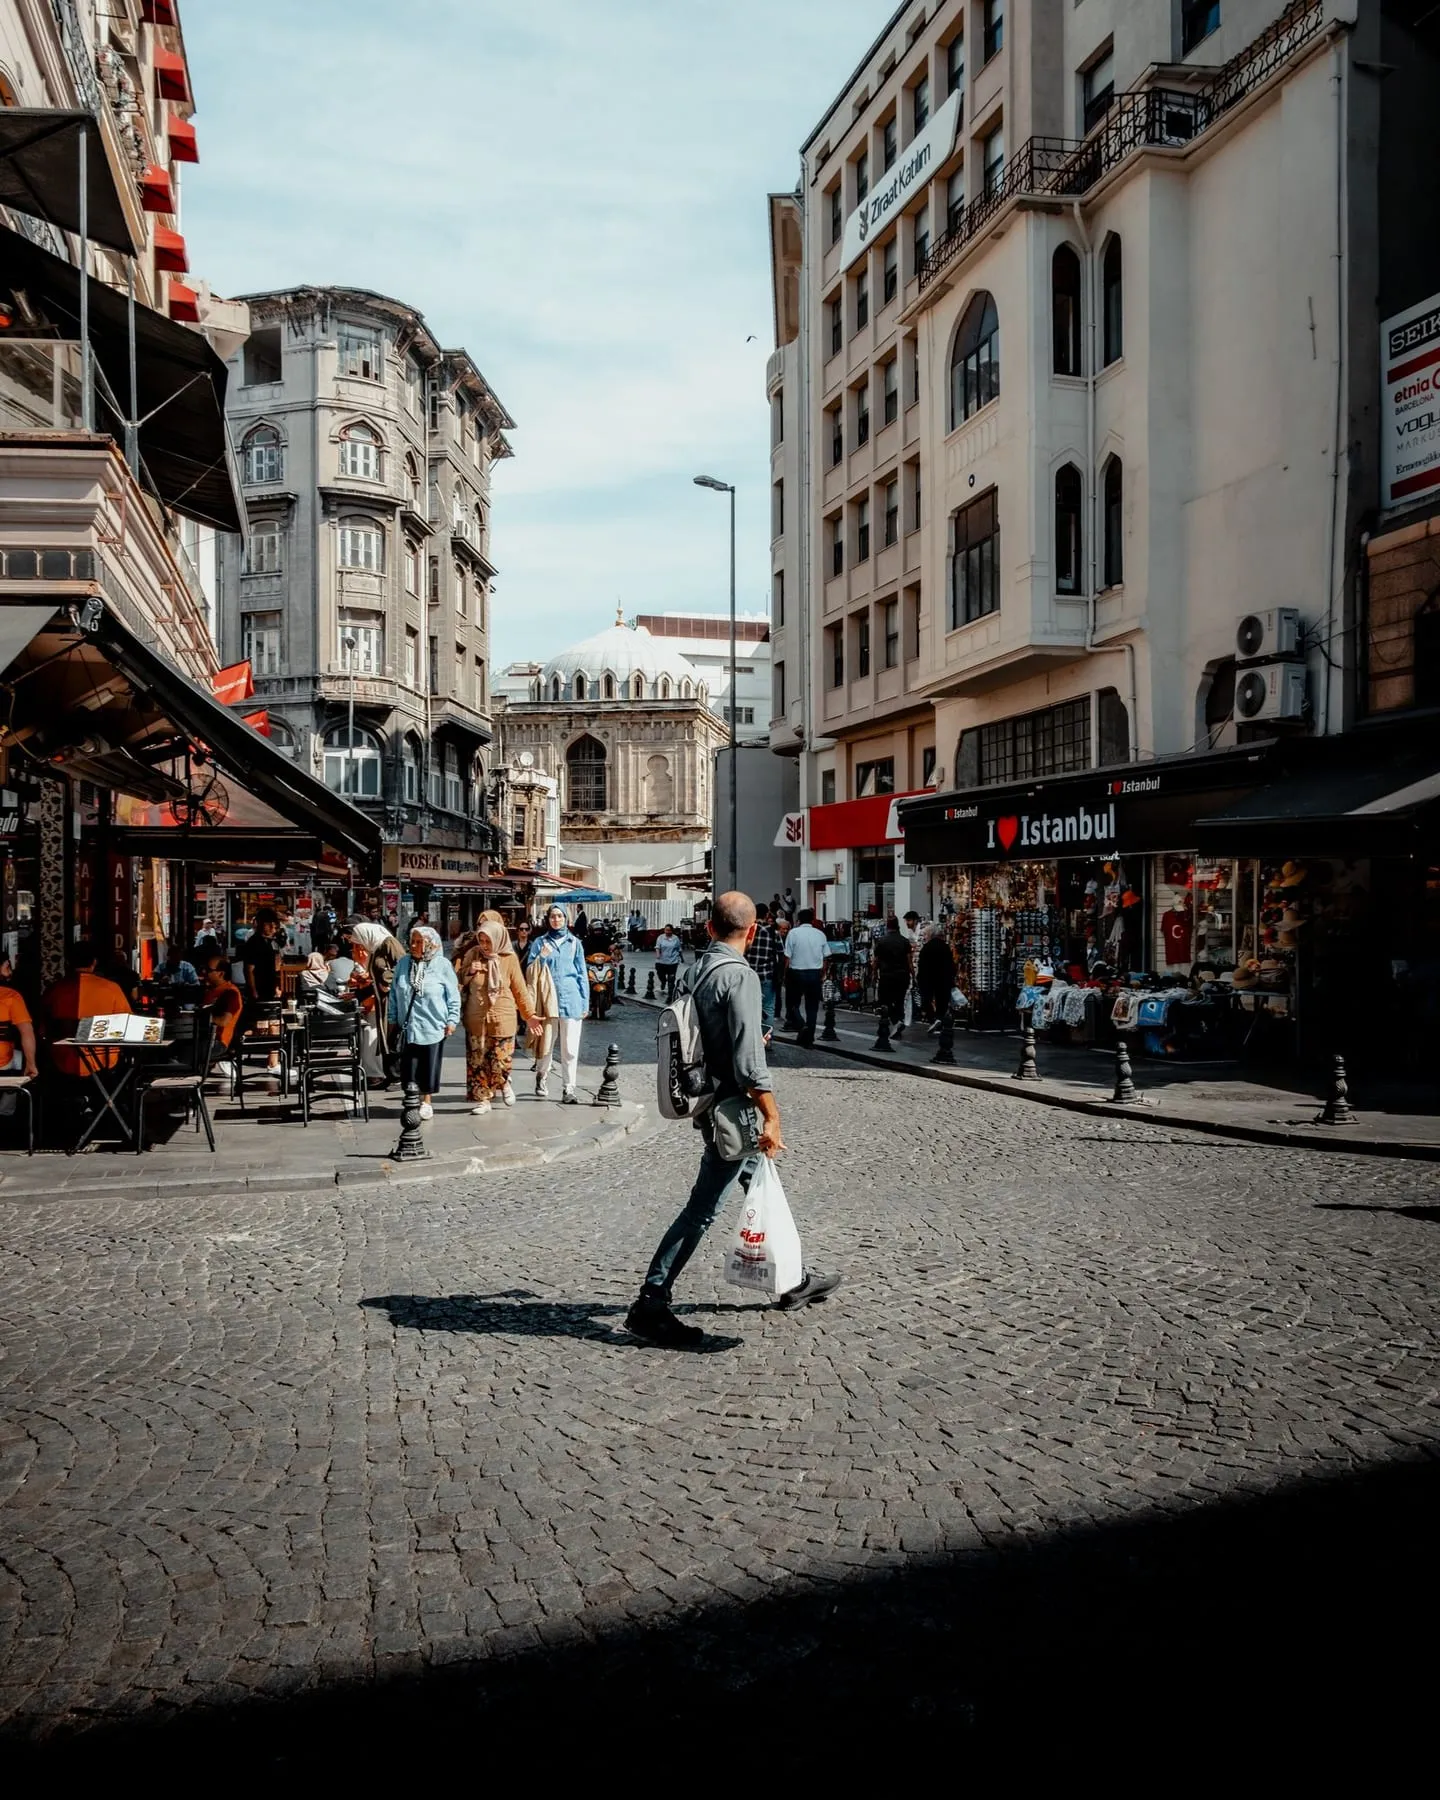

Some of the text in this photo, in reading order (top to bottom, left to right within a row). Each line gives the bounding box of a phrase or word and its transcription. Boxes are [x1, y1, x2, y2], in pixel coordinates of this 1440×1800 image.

[871, 178, 898, 225] Ziraat
[1394, 378, 1430, 403] etnia
[1395, 393, 1434, 415] BARCELONA
[1107, 775, 1161, 795] I Istanbul
[944, 805, 978, 821] I Istanbul
[986, 802, 1116, 849] I Istanbul
[400, 852, 440, 870] KOSKA
[670, 1039, 684, 1108] LACOSTE
